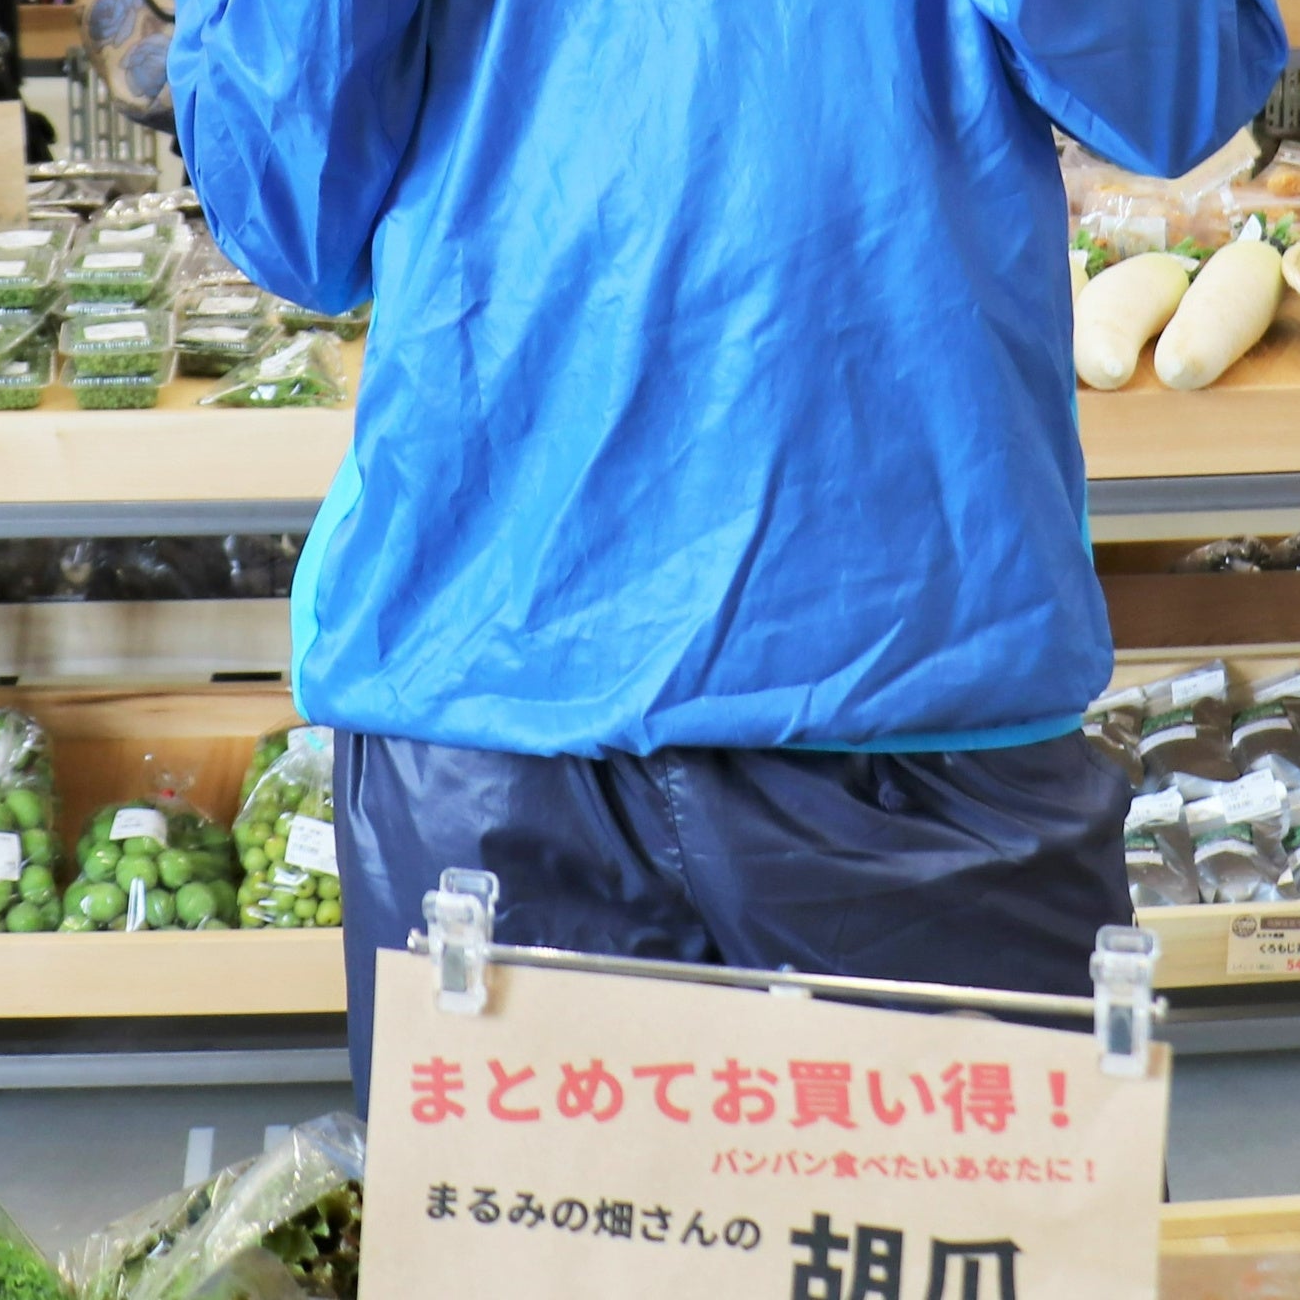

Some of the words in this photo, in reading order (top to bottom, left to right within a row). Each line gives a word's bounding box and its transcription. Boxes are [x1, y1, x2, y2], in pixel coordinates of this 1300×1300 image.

[408, 1054, 1075, 1136] まとめてお買い得！
[426, 1179, 763, 1253] まるみの畑さんの
